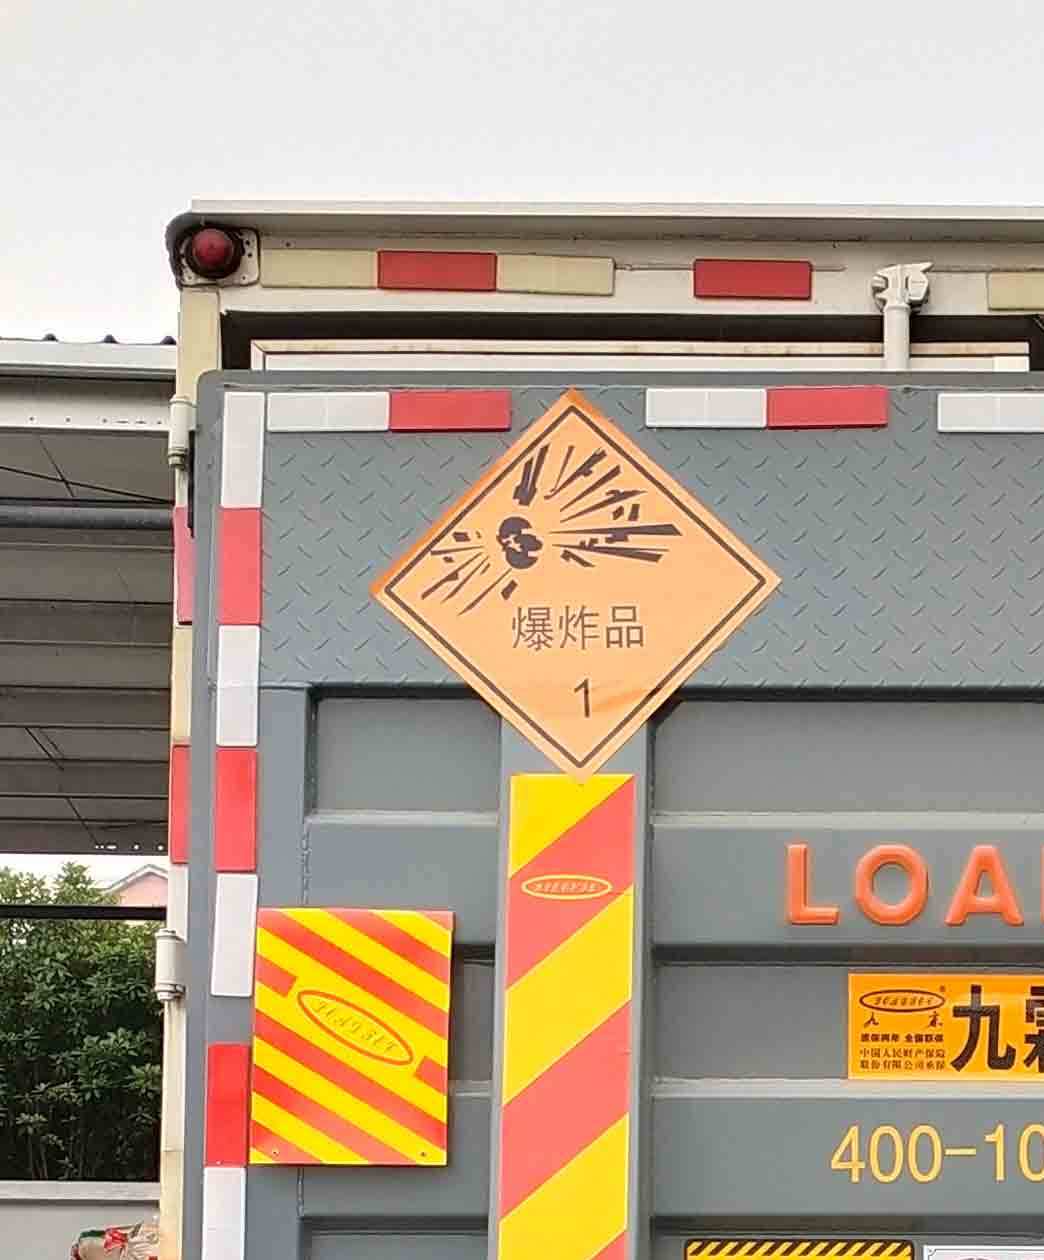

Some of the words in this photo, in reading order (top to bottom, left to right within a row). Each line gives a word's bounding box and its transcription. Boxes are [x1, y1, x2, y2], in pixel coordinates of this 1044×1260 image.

[511, 604, 645, 651] 爆炸品
[573, 679, 591, 718] 1
